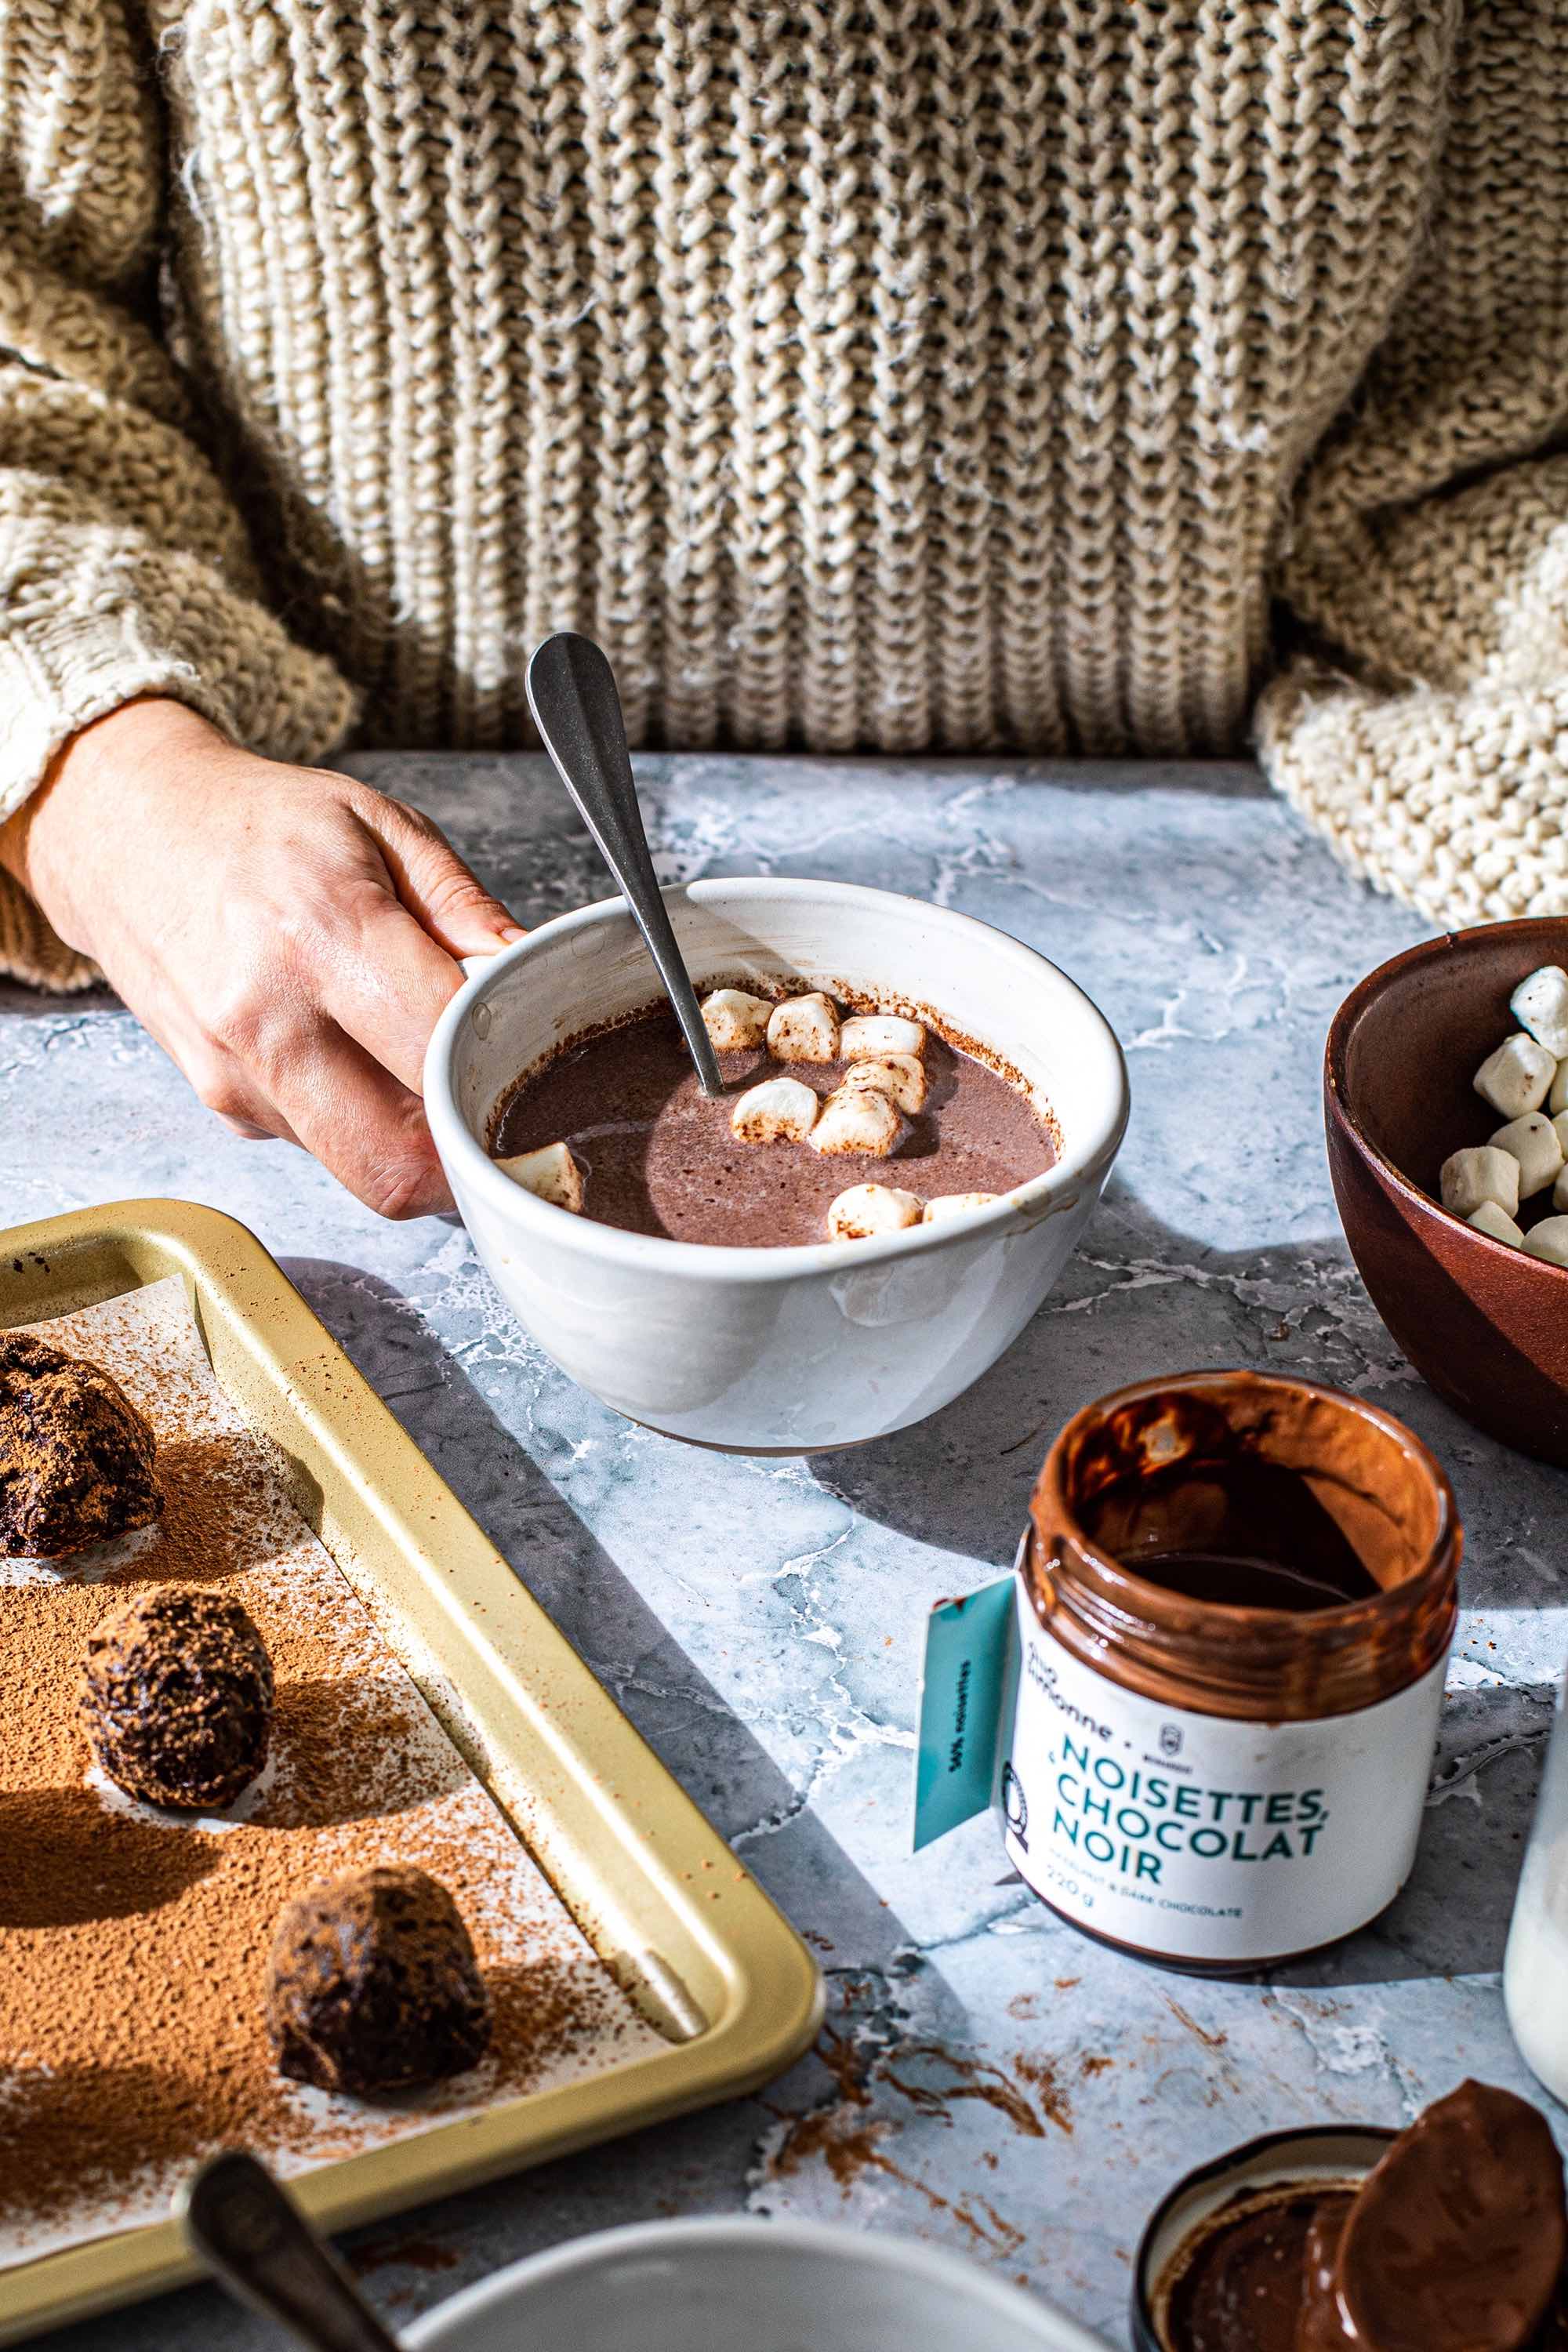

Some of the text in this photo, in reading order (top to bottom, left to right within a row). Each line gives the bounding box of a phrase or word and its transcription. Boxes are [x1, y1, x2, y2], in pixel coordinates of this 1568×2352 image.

[956, 1659, 971, 1734] noisettes
[1062, 1733, 1330, 1824] NOISETTES,
[1053, 1806, 1162, 1886] NOIR
[1058, 1773, 1323, 1862] CHOCOLAT
[1082, 1893, 1095, 1908] g
[1158, 1898, 1243, 1919] CHOCOLATE
